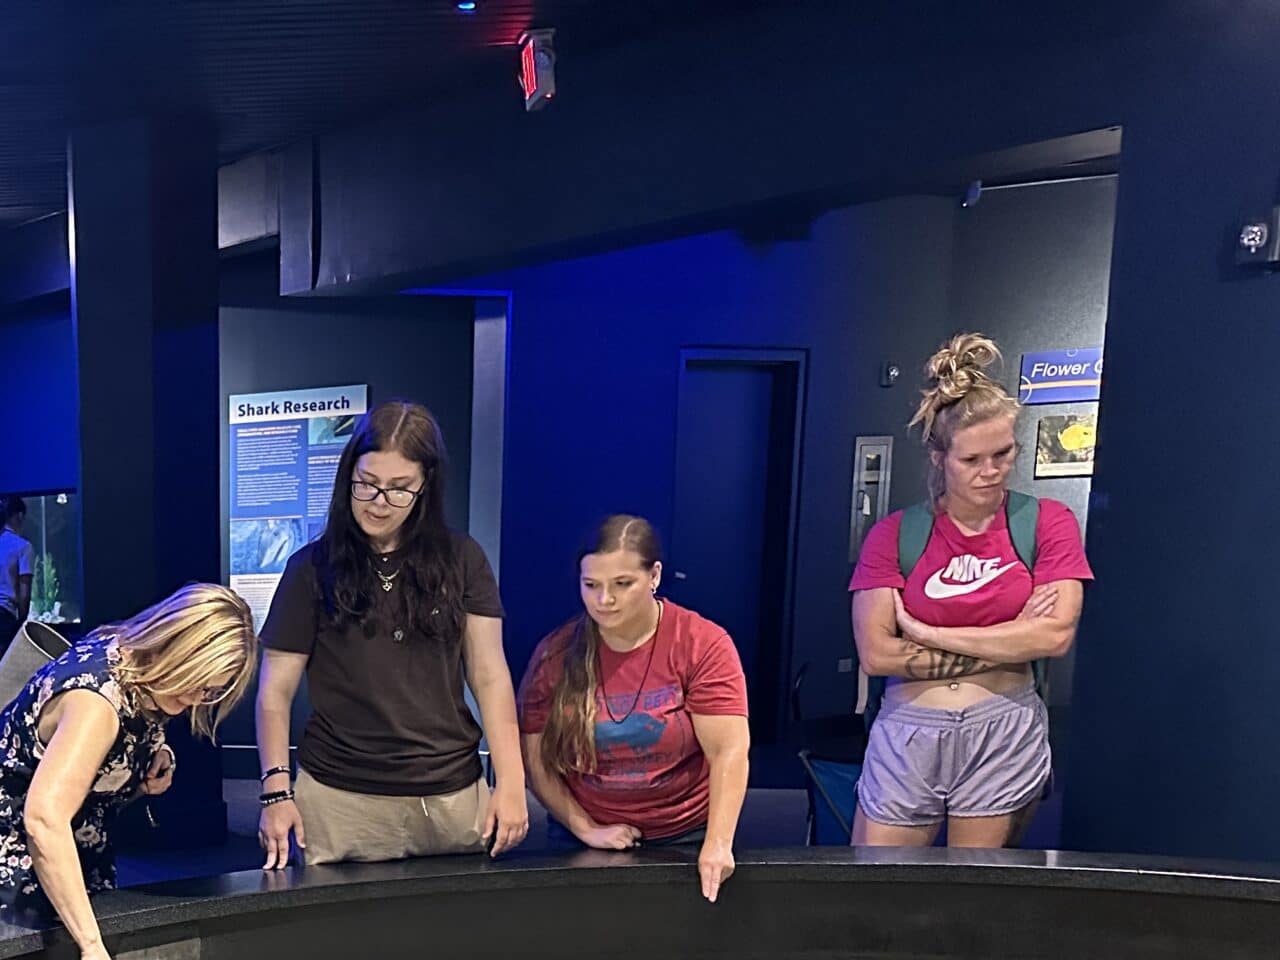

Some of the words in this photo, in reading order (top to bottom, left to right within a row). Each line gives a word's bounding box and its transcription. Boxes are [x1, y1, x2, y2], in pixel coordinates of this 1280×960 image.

[1031, 362, 1090, 377] Flower
[238, 401, 280, 417] Shark
[283, 395, 351, 414] Research
[942, 554, 1001, 582] NIKE
